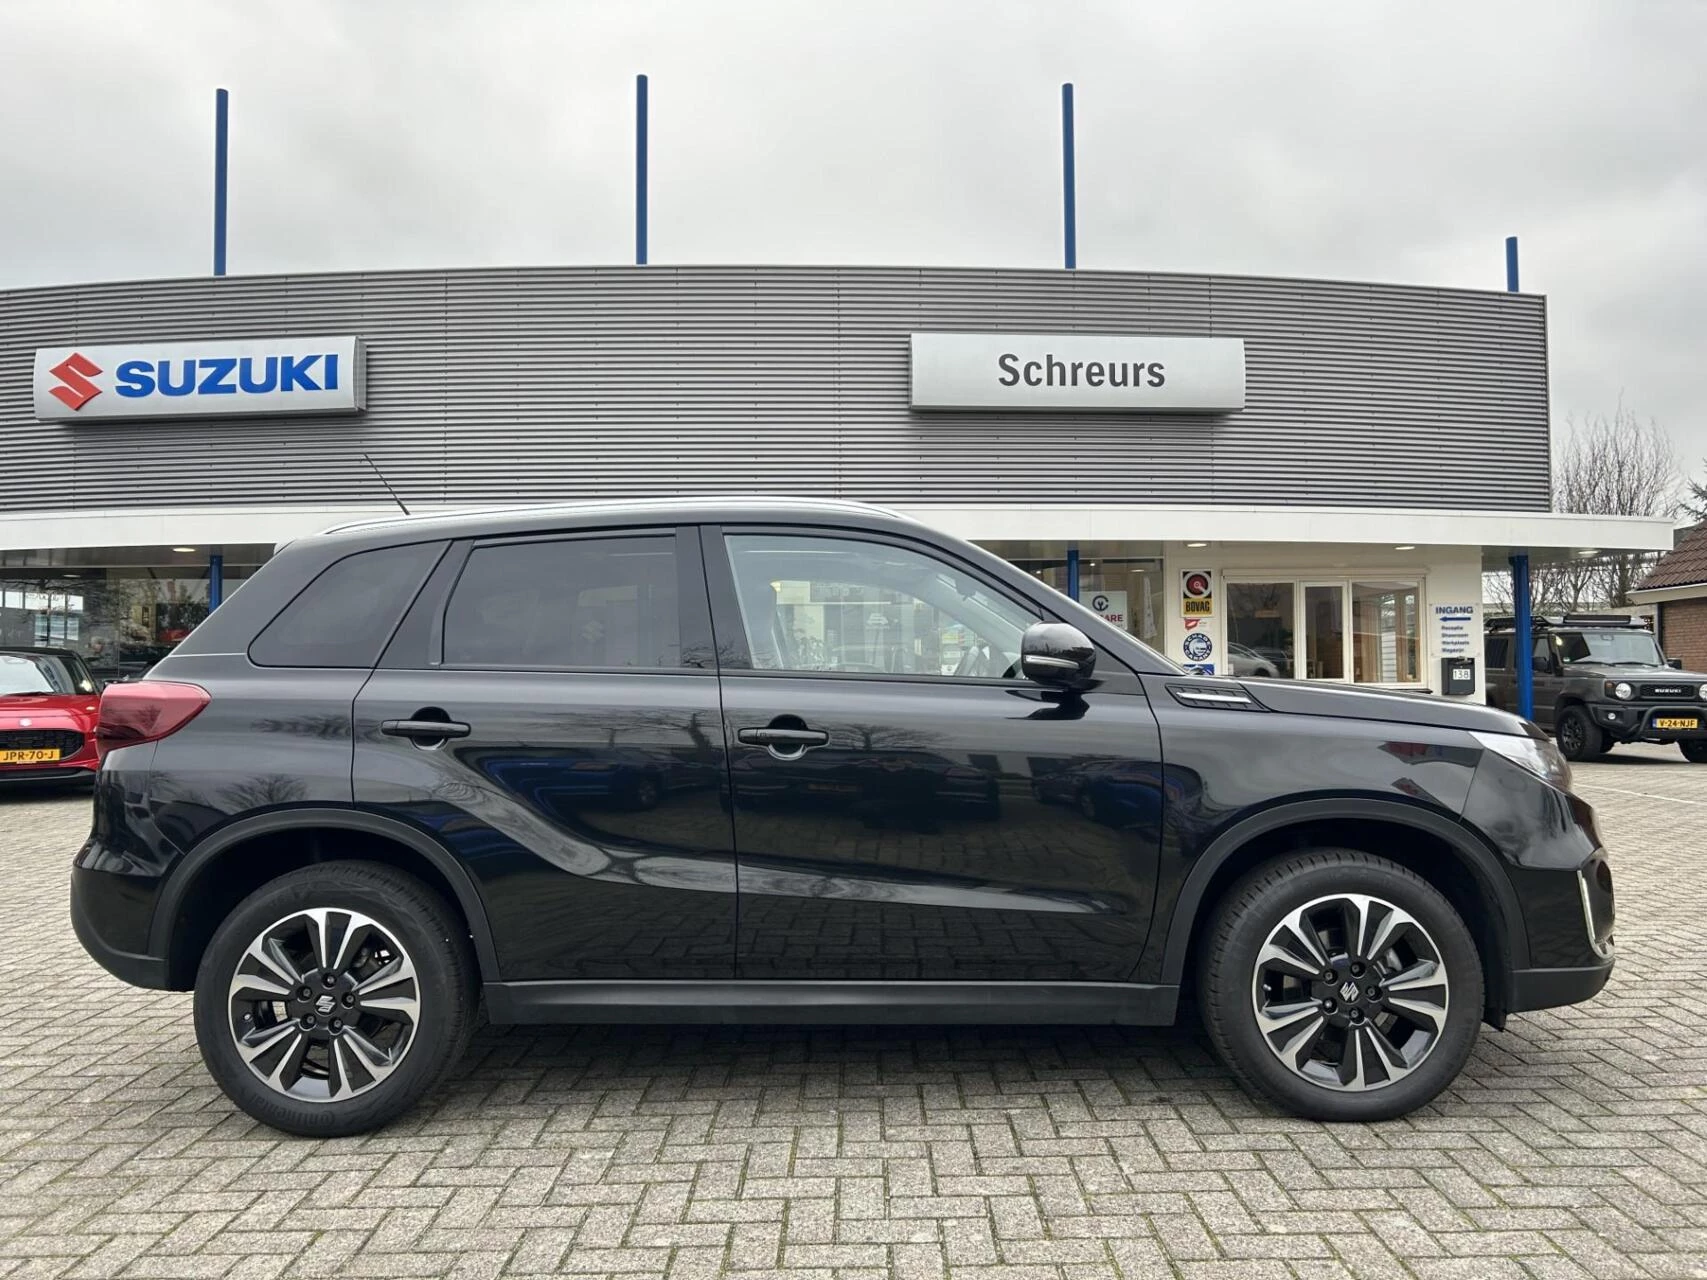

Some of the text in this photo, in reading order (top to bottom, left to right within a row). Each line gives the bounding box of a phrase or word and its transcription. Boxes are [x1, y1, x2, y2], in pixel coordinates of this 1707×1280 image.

[115, 353, 339, 397] SUZUKI
[998, 353, 1165, 388] Schreurs
[1185, 601, 1210, 612] BOVAG
[1435, 606, 1474, 614] INGANG
[1454, 670, 1469, 679] 138
[1659, 719, 1696, 727] V-24-NJF
[3, 751, 54, 761] JPR-70-J
